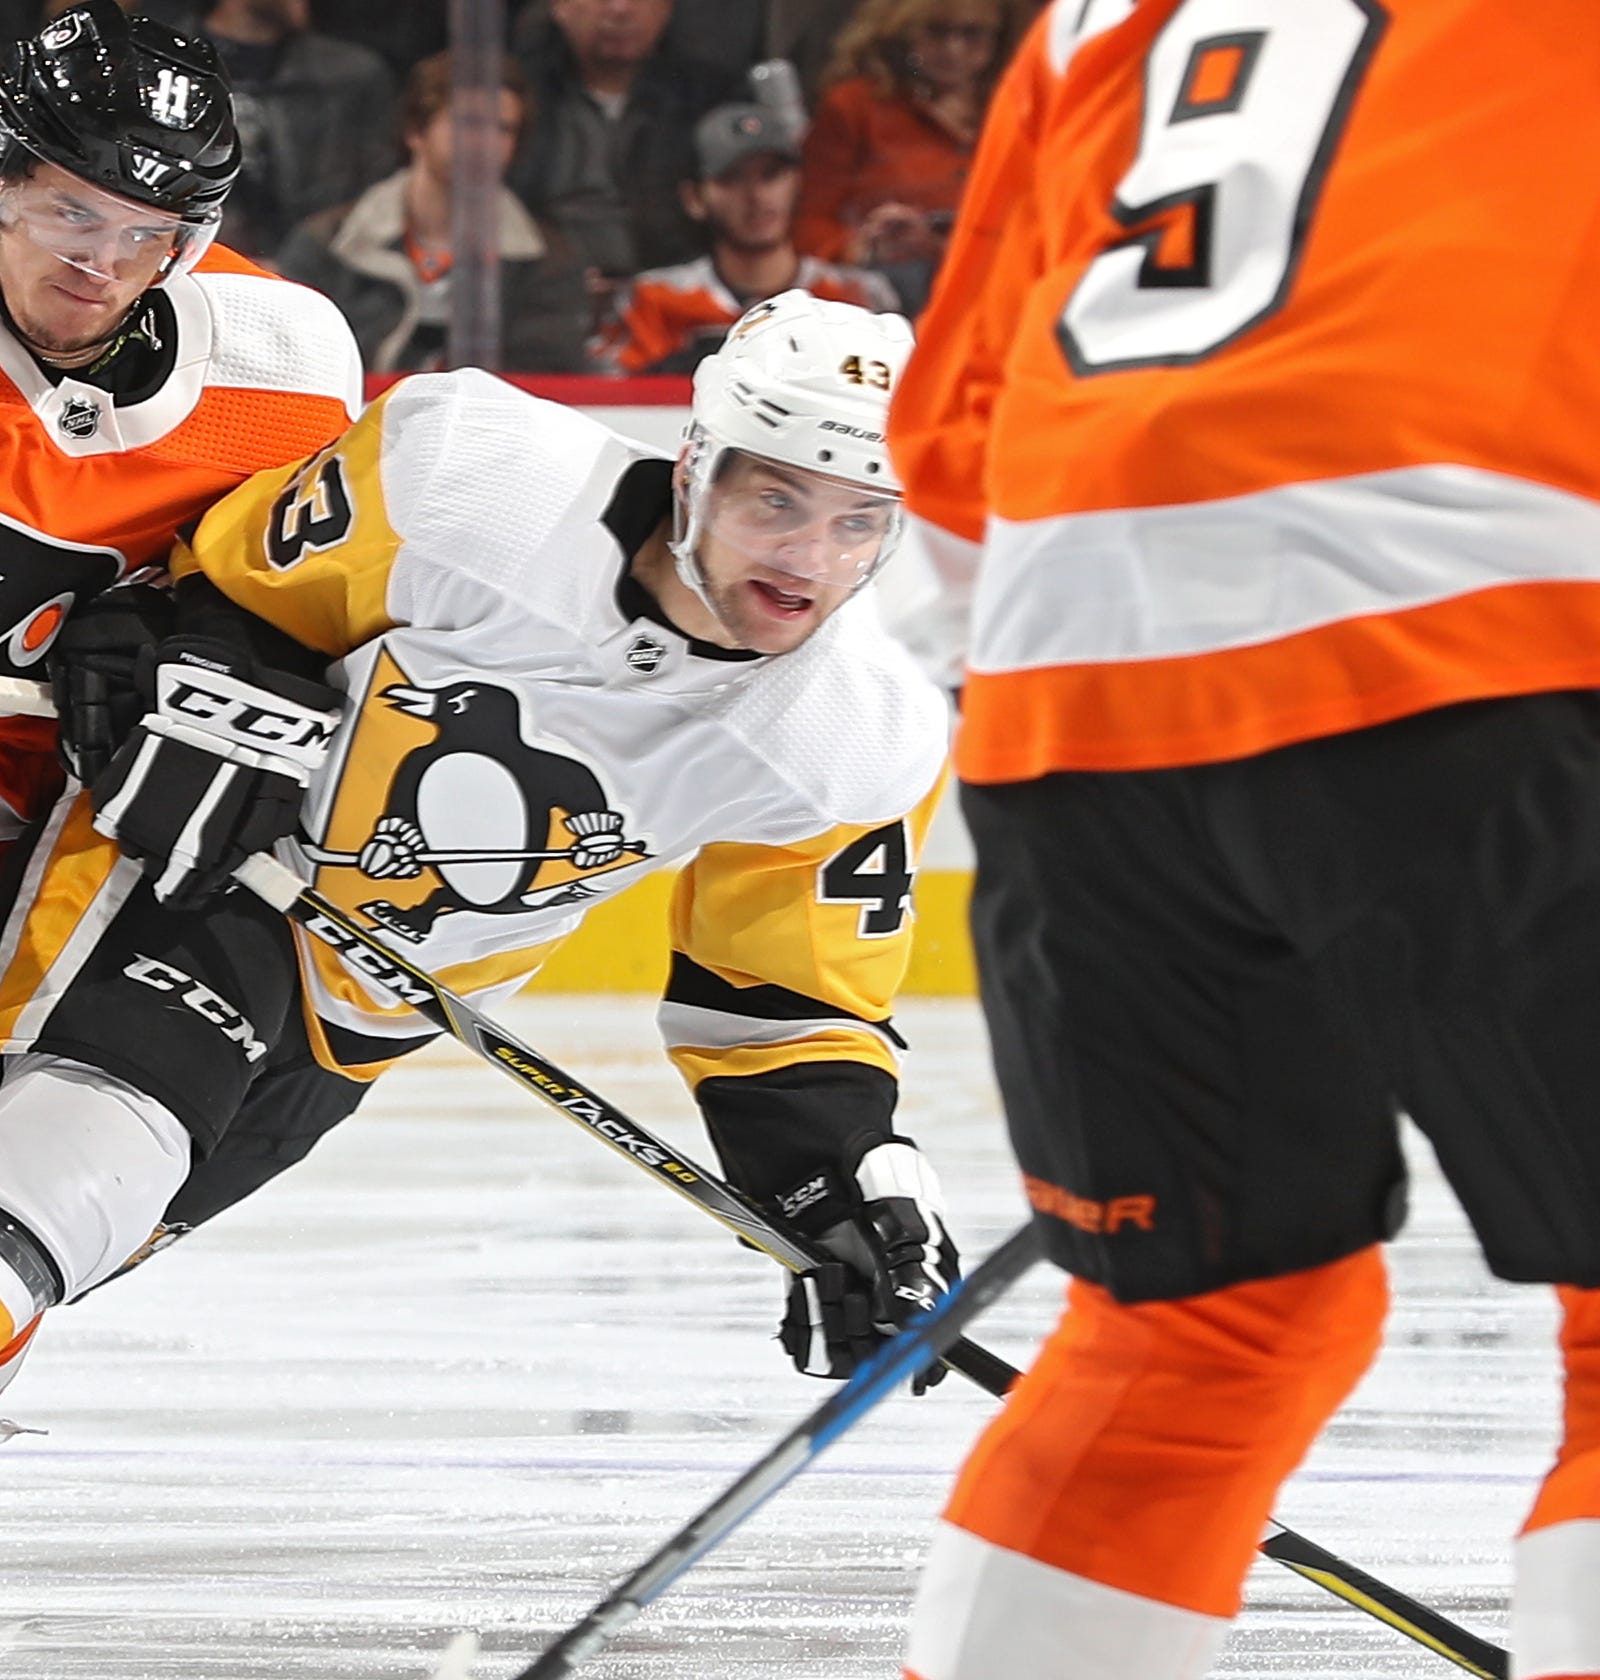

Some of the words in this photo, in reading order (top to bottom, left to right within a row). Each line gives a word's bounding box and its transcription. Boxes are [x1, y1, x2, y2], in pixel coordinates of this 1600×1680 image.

[1054, 0, 1390, 378] 9
[838, 353, 891, 392] 43
[164, 679, 338, 751] CCM
[815, 815, 919, 939] 4
[304, 913, 436, 1006] CCM
[122, 952, 268, 1064] CCM
[556, 1088, 669, 1167] TACKS
